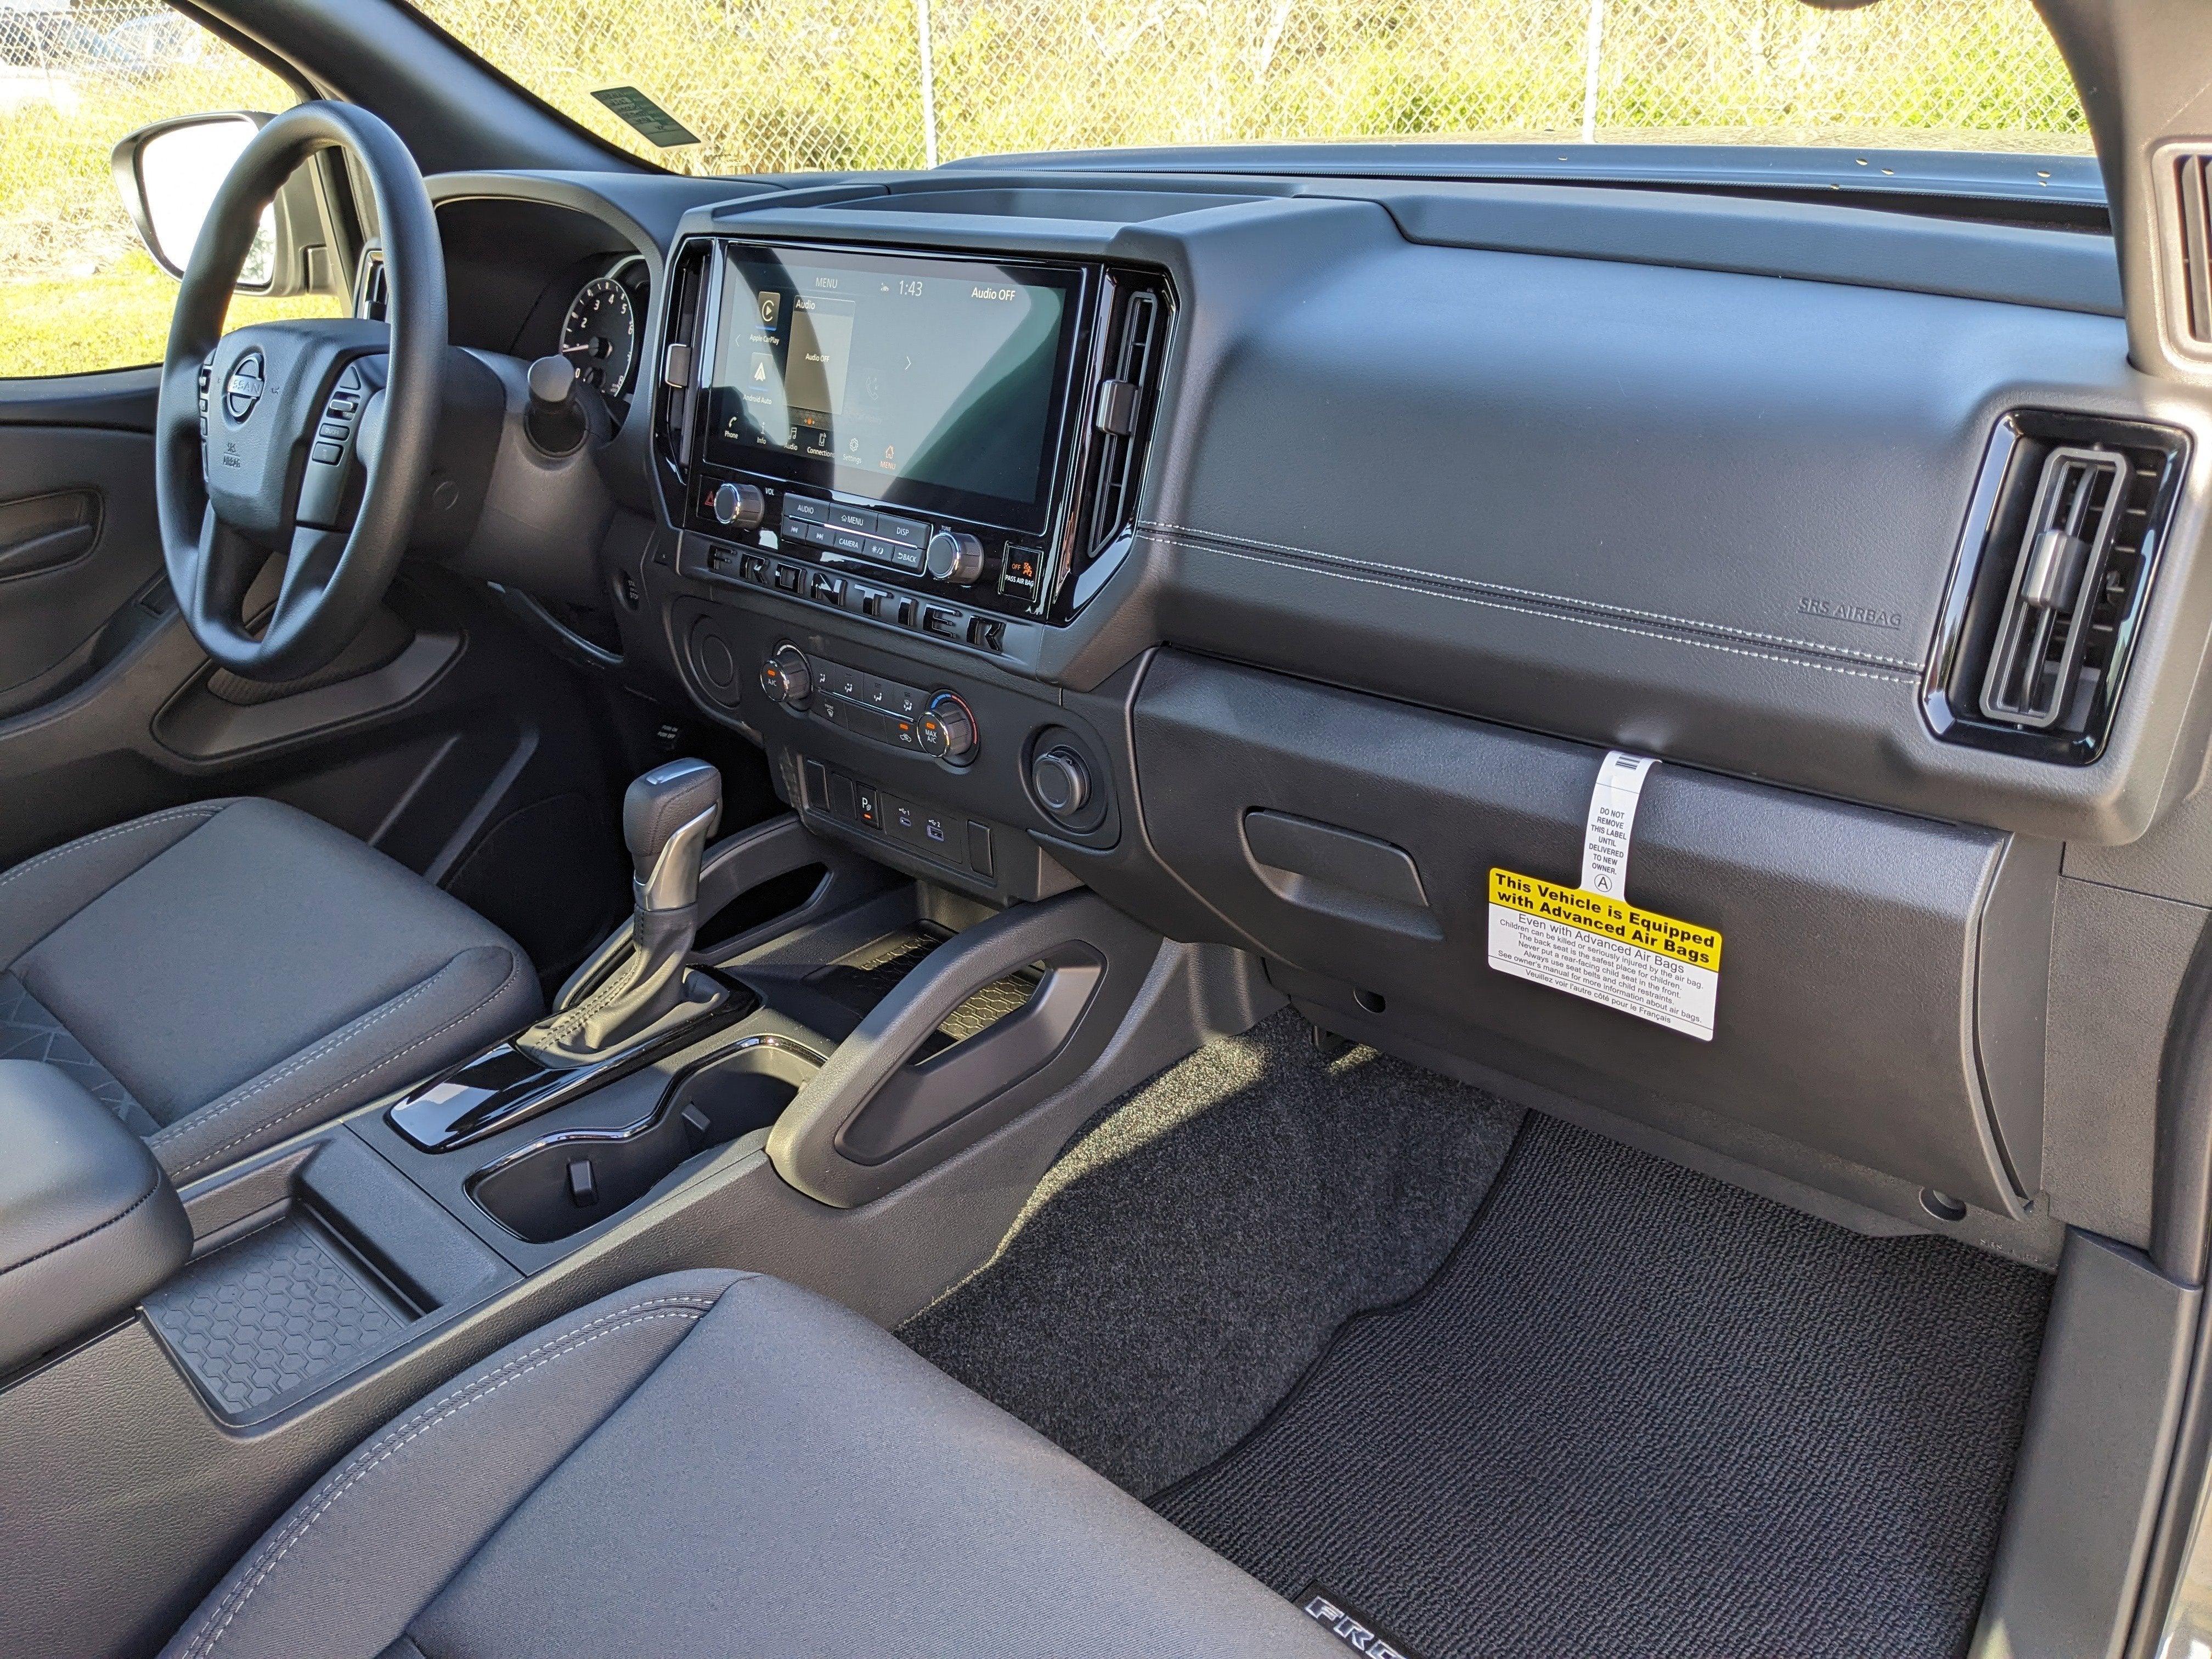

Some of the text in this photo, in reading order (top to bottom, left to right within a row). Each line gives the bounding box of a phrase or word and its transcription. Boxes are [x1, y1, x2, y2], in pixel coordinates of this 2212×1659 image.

[815, 277, 838, 289] MENU
[899, 280, 923, 297] 1:43
[608, 294, 614, 304] 4
[971, 287, 1015, 301] Audio OFF
[594, 300, 600, 311] 3
[620, 303, 627, 314] 5
[795, 300, 815, 310] Audio
[581, 317, 587, 328] 2
[749, 334, 780, 345] Apple CarPlay
[805, 353, 820, 362] Audio
[575, 368, 580, 379] 0
[227, 378, 261, 394] SSAN
[743, 394, 772, 405] Android Auto
[724, 430, 738, 439] Phone
[757, 437, 766, 445] Info
[784, 442, 798, 451] Audio
[806, 446, 835, 458] Connections
[843, 453, 862, 465] Settings
[879, 461, 896, 470] MENU
[765, 487, 775, 496] VOL
[797, 504, 814, 515] AUDIO
[847, 516, 864, 527] MENU
[896, 527, 910, 537] DISP
[839, 538, 859, 549] CAMERA
[903, 553, 917, 563] BACK
[1005, 574, 1016, 583] PASS
[708, 544, 1006, 653] FRONTIER
[1797, 597, 1902, 627] SRS AIRBAG
[768, 679, 777, 687] A/C
[925, 729, 937, 738] MAX
[927, 736, 936, 744] A/C
[862, 797, 868, 809] P
[1599, 806, 1624, 819] DO NOT
[1596, 816, 1624, 829] REMOVE
[1590, 823, 1626, 840] THIS LABEL
[1598, 836, 1616, 847] UNTIL
[1588, 843, 1624, 858] DELIVERED
[1593, 853, 1618, 865] TO NEW
[1592, 862, 1616, 875] OWNER.
[1495, 872, 1714, 948] This Vehicle is Equipped
[1497, 891, 1709, 963] with Advanced Air Bags
[1519, 913, 1684, 973] Even with Advanced Air Bags
[1499, 918, 1529, 933] Children
[1531, 929, 1544, 937] can
[1545, 932, 1555, 940] be
[1557, 935, 1576, 947] killed
[1587, 946, 1620, 962] seriously
[1622, 956, 1647, 970] injured
[1649, 964, 1658, 974] by
[1660, 969, 1672, 978] the
[1686, 977, 1703, 989] bag.
[1518, 932, 1532, 941] The
[1533, 936, 1550, 947] back
[1553, 944, 1568, 953] seat
[1578, 950, 1589, 960] the
[1592, 956, 1614, 967] safest
[1616, 963, 1635, 974] place
[1638, 969, 1648, 978] for
[1650, 975, 1681, 990] children.
[1518, 940, 1539, 952] Never
[1541, 948, 1553, 956] put
[1561, 955, 1600, 972] rear-facing
[1601, 967, 1619, 977] child
[1621, 974, 1637, 984] seat
[1639, 978, 1645, 986] in
[1647, 981, 1660, 991] the
[1662, 986, 1680, 998] front.
[1523, 950, 1674, 1005] Always use seat belts and child restraints.
[1498, 950, 1512, 960] See
[1543, 965, 1569, 977] manual
[1571, 972, 1581, 981] for
[1582, 978, 1601, 988] more
[1603, 983, 1644, 1002] information
[1646, 999, 1667, 1011] about
[1681, 1009, 1701, 1023] bags.
[1525, 968, 1553, 983] Veuillez
[1554, 979, 1568, 988] voir
[1593, 992, 1609, 1001] côté
[1611, 998, 1628, 1008] pour
[1630, 1003, 1637, 1011] le
[1639, 1006, 1671, 1023] Français
